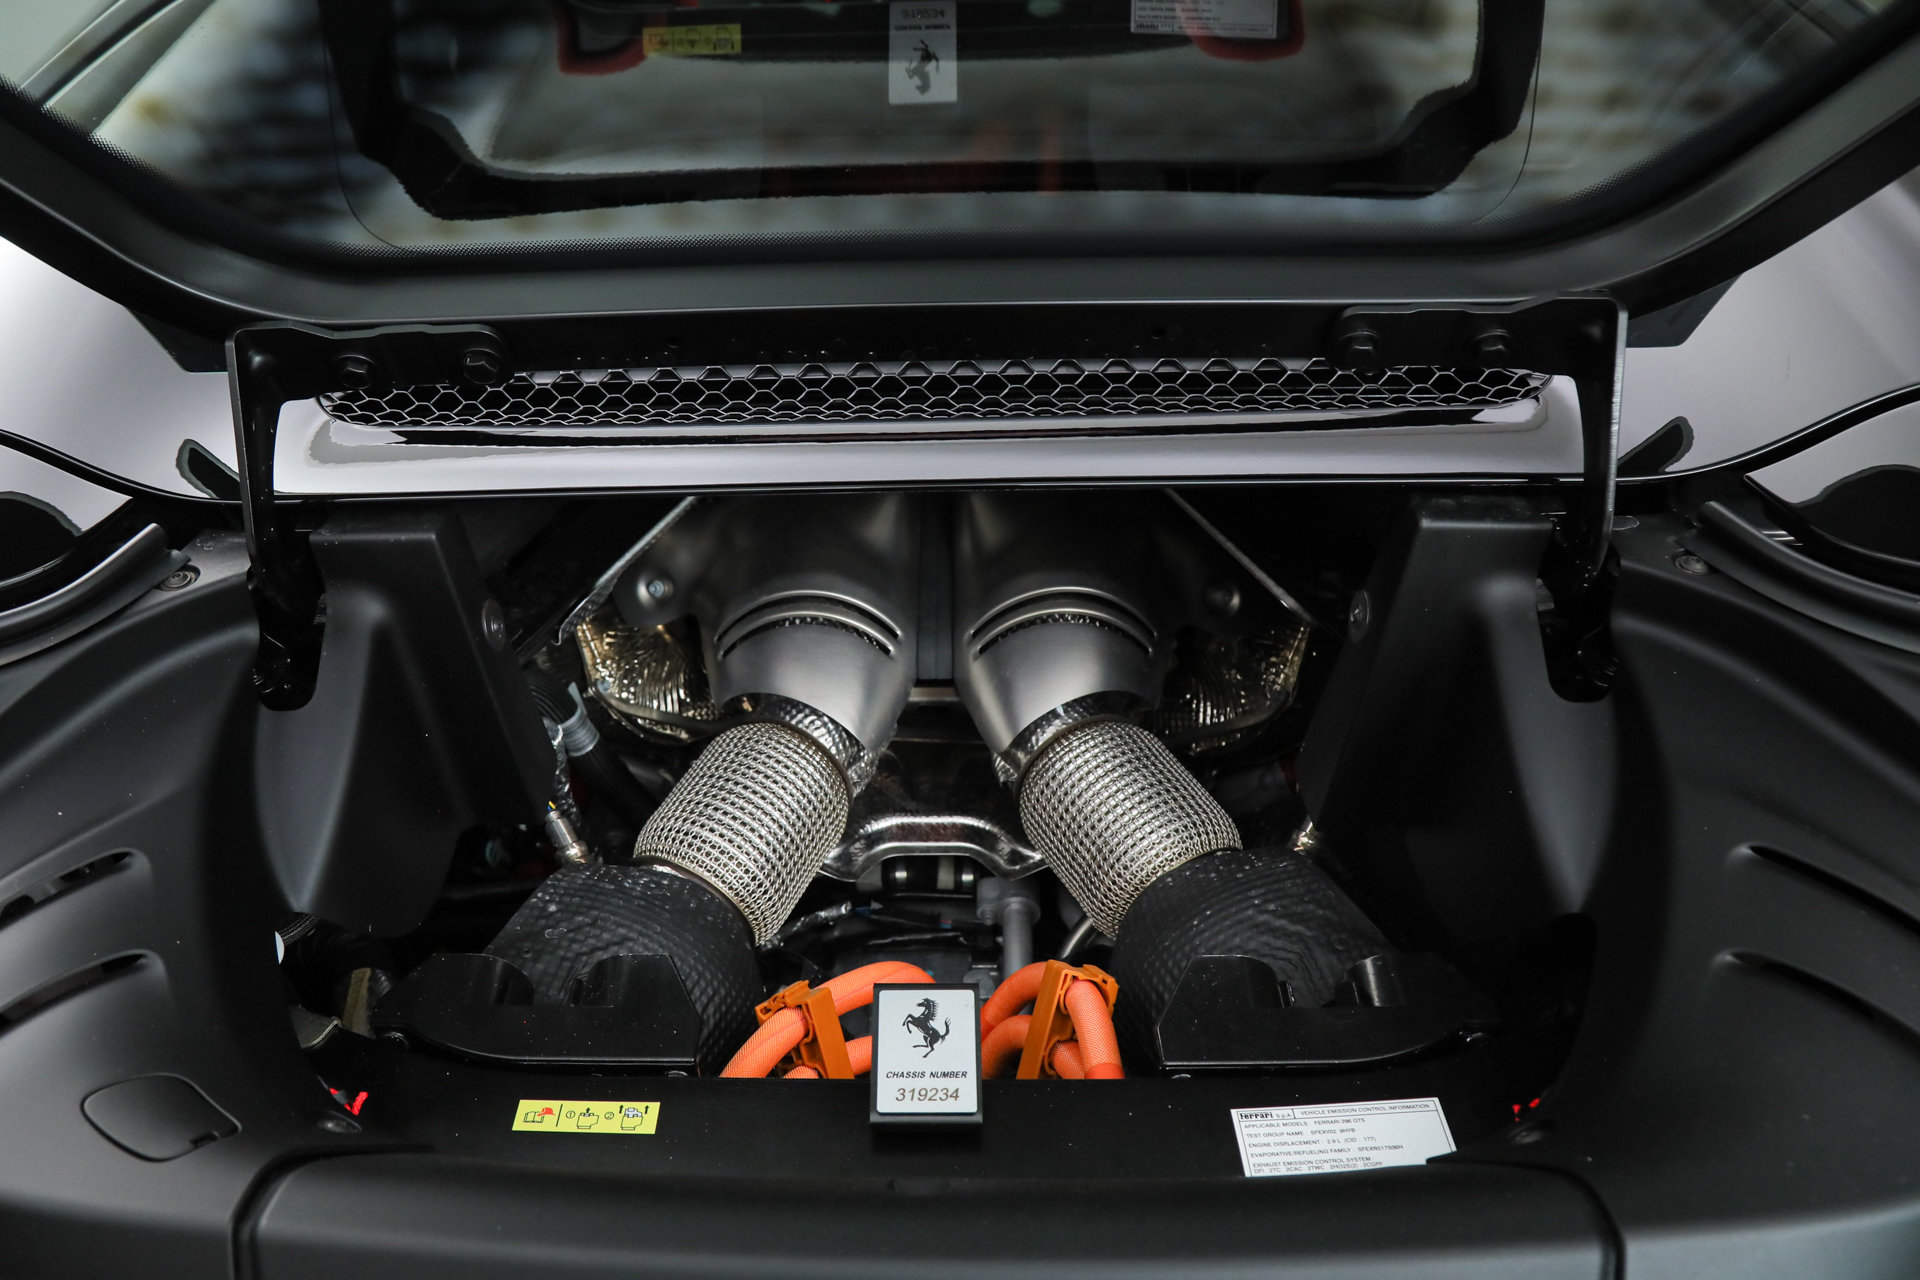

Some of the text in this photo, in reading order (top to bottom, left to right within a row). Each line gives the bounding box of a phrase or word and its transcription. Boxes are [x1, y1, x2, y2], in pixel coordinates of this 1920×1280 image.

[886, 1071, 968, 1079] CHASSIS NUMBER
[895, 1087, 960, 1102] 319234
[1327, 1107, 1357, 1115] EMISSION
[1388, 1103, 1430, 1111] INFORMATION
[1240, 1111, 1274, 1120] Ferrari
[1273, 1139, 1321, 1147] DISPLACEMENT
[1283, 1159, 1314, 1167] EMISSION
